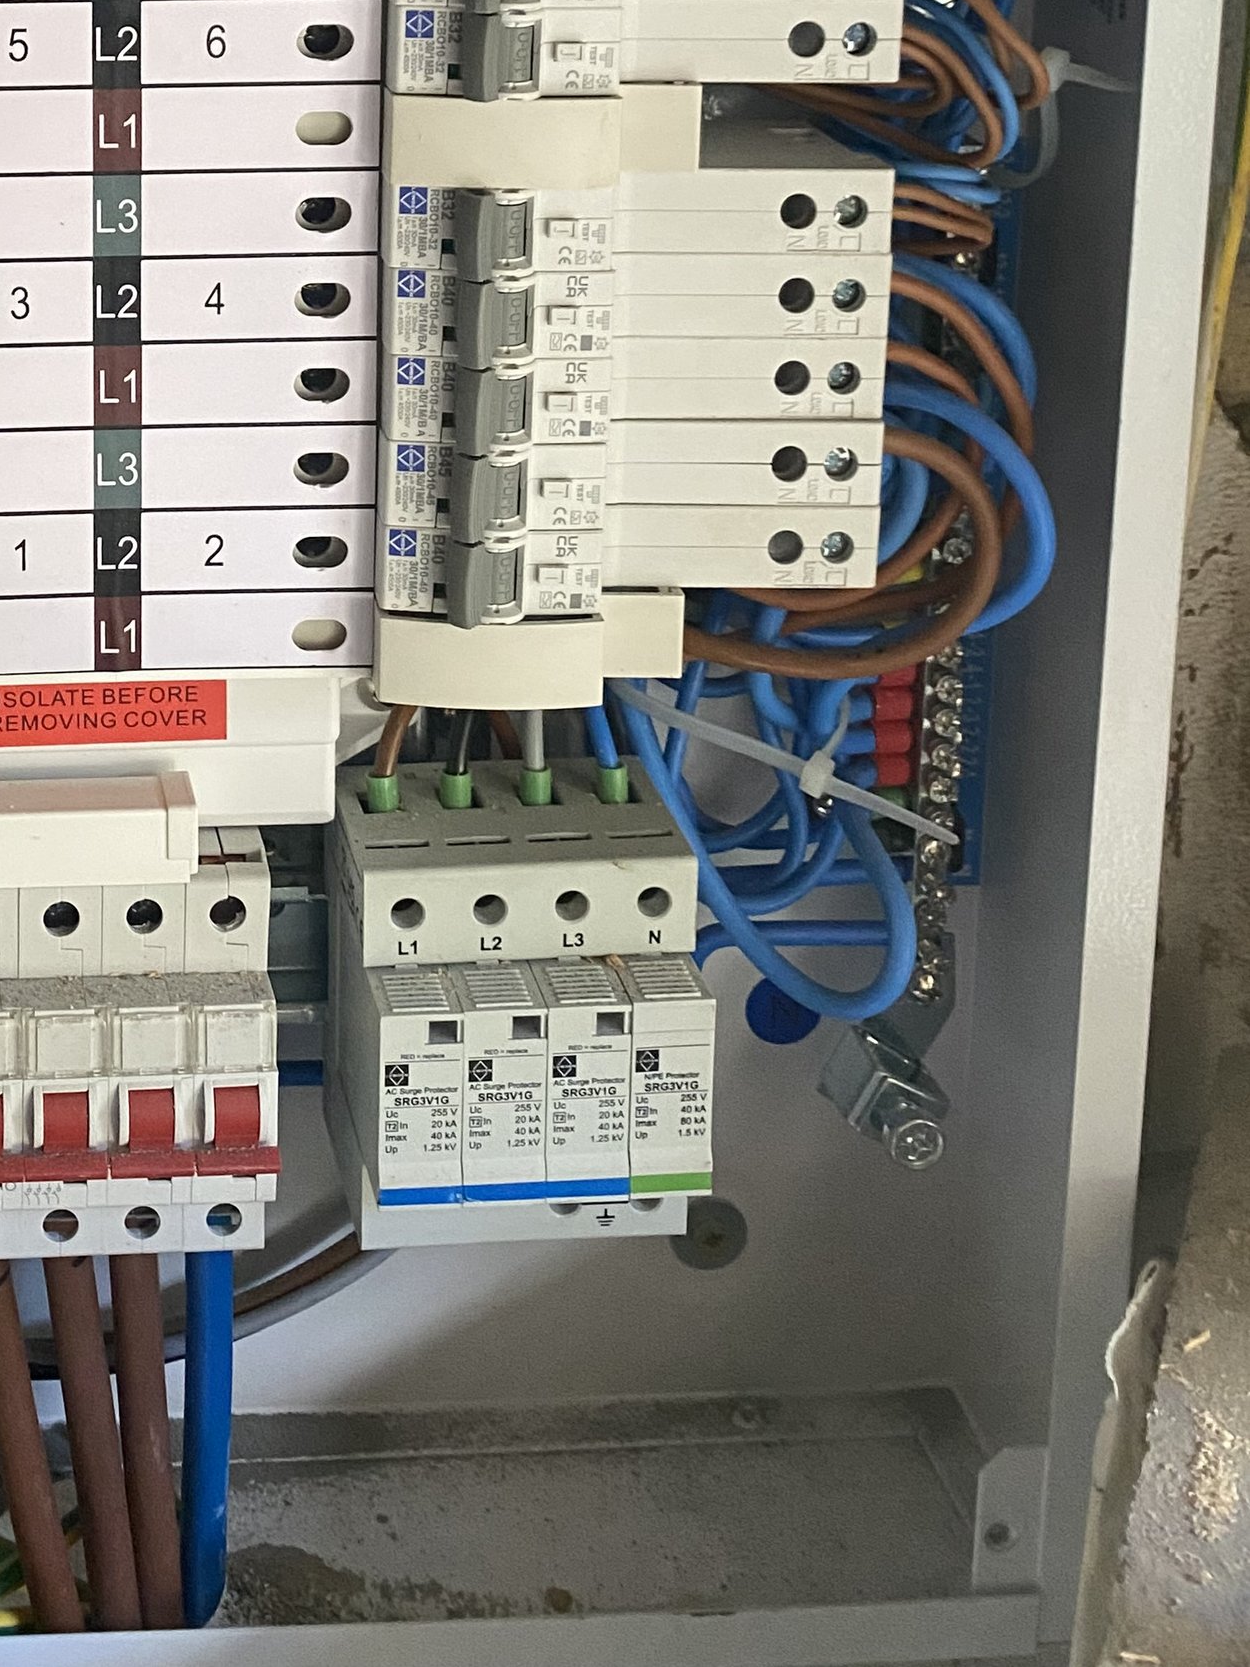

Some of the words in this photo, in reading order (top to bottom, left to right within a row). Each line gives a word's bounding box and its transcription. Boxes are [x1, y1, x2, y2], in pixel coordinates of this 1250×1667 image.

[8, 28, 29, 63] 5
[95, 26, 138, 62] L2
[206, 24, 227, 59] 6
[98, 113, 136, 149] L1
[96, 198, 139, 234] L3
[442, 276, 455, 306] B40
[10, 286, 30, 320] 3
[96, 284, 138, 319] L2
[204, 282, 225, 315] 4
[99, 369, 137, 404] L1
[438, 447, 452, 477] B45
[96, 451, 139, 487] L3
[14, 538, 26, 572] 1
[96, 535, 138, 570] L2
[204, 534, 224, 567] 2
[100, 619, 136, 654] L1
[103, 685, 199, 705] BEFORE
[124, 709, 207, 729] COVER
[562, 933, 584, 948] L3
[649, 930, 662, 944] N
[397, 941, 419, 956] L1
[480, 937, 503, 951] L2
[483, 1083, 506, 1092] Surge
[567, 1079, 590, 1087] Surge
[644, 1081, 699, 1092] SRG3V1G
[399, 1088, 423, 1096] Surge
[424, 1086, 459, 1094] Protector
[478, 1091, 533, 1102] SRG3V1G
[562, 1087, 617, 1098] SRG3V1G
[394, 1096, 449, 1107] SRG3V1G
[553, 1102, 567, 1110] Uc
[598, 1099, 616, 1108] 255
[636, 1096, 649, 1104] Uc
[680, 1094, 697, 1102] 255
[386, 1110, 399, 1119] Uc
[431, 1108, 448, 1117] 255
[469, 1106, 483, 1114] Uc
[514, 1104, 532, 1112] 255
[599, 1111, 610, 1119] 20
[612, 1110, 625, 1118] kA
[680, 1105, 692, 1113] 40
[694, 1105, 706, 1113] kA
[431, 1120, 443, 1128] 20
[445, 1119, 457, 1128] kA
[515, 1115, 526, 1124] 20
[529, 1115, 541, 1123] kA
[635, 1119, 657, 1127] Imax
[680, 1117, 692, 1125] 80
[694, 1117, 706, 1125] kA
[469, 1129, 491, 1137] Imax
[514, 1127, 526, 1135] 40
[529, 1127, 541, 1135] kA
[553, 1124, 575, 1133] Imax
[598, 1123, 610, 1131] 40
[612, 1122, 624, 1130] kA
[385, 1133, 407, 1142] Imax
[430, 1132, 443, 1140] 40
[445, 1131, 457, 1139] kA
[552, 1137, 566, 1146] Up
[590, 1135, 609, 1143] 1.25
[612, 1134, 624, 1142] kV
[635, 1131, 648, 1141] Up
[678, 1129, 691, 1137] 1.5
[385, 1146, 398, 1155] Up
[423, 1144, 443, 1152] 1.25
[444, 1143, 457, 1151] kV
[469, 1141, 482, 1151] Up
[507, 1139, 526, 1147] 1.25
[528, 1139, 540, 1147] kV
